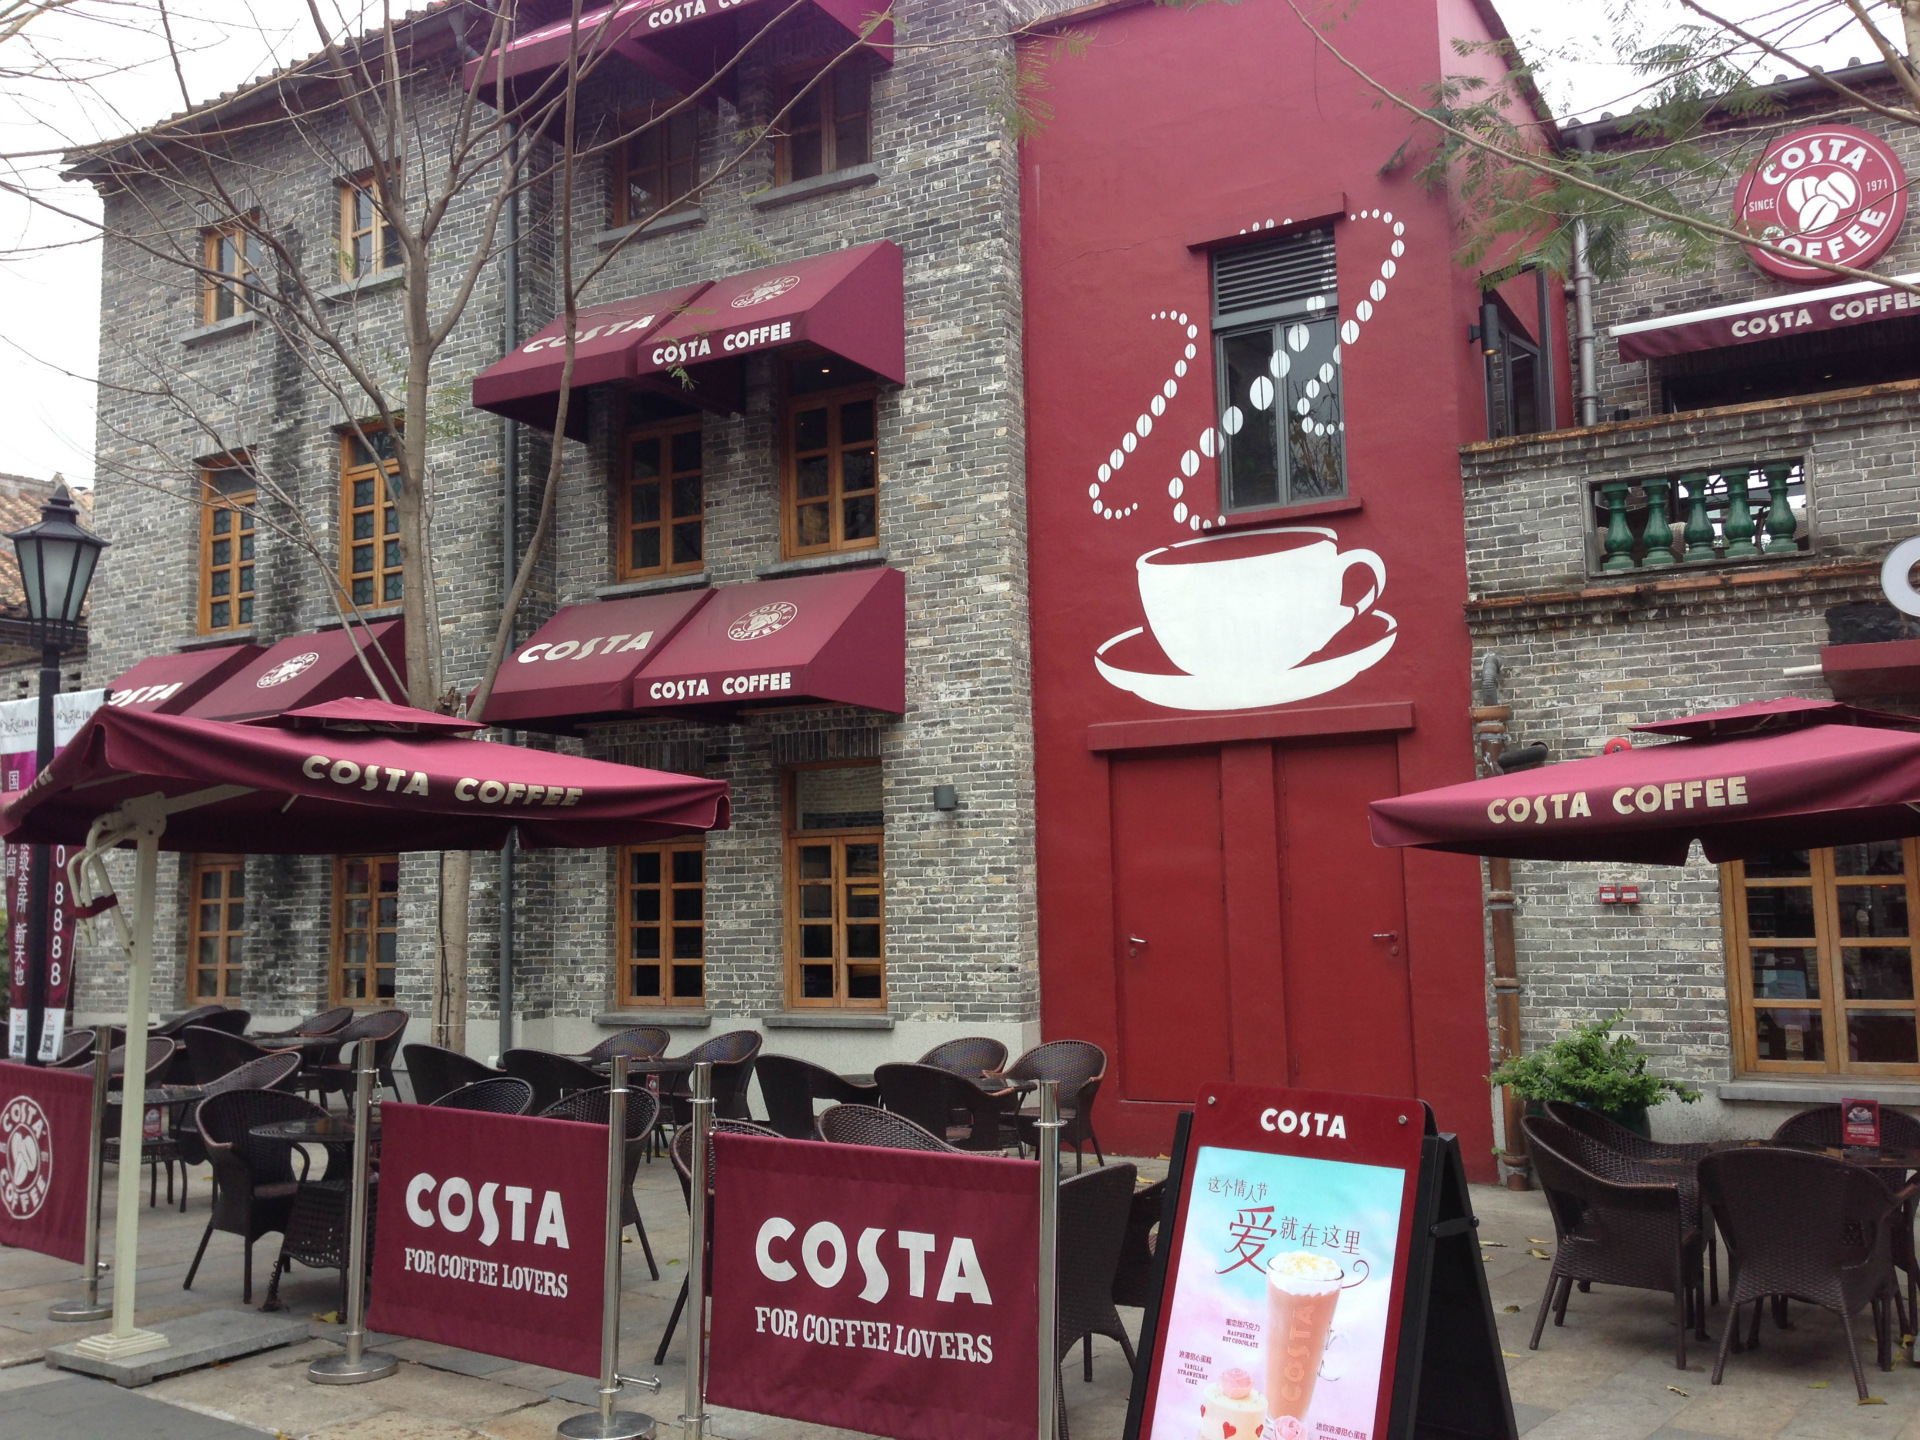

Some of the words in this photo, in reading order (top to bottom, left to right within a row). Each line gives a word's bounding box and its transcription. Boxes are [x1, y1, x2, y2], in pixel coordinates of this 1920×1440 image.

[648, 0, 707, 29] COSTA
[1762, 139, 1867, 185] COSTA
[1866, 179, 1889, 192] 1971
[1749, 198, 1775, 213] SINCE
[522, 314, 656, 354] COSTA
[1731, 309, 1813, 338] COSTA
[652, 338, 712, 366] COSTA
[723, 321, 791, 352] COFFEE
[517, 630, 655, 664] COSTA
[107, 681, 184, 707] OSTA
[650, 679, 709, 700] COSTA
[722, 672, 791, 695] COFFEE
[302, 754, 429, 797] COSTA
[454, 777, 584, 807] COFFEE
[1487, 791, 1592, 825] COSTA
[1612, 776, 1749, 815] COFFEE
[3, 1102, 43, 1140] COSTA
[1260, 1107, 1347, 1140] COSTA
[0, 1168, 47, 1214] COFFEE
[1207, 1176, 1269, 1203] 这个情人节
[405, 1172, 570, 1250] COSTA
[404, 1247, 437, 1276] FOR
[438, 1253, 498, 1288] COFFEE
[501, 1263, 568, 1299] LOVERS
[755, 1216, 993, 1306] COSTA
[755, 1306, 799, 1340] FOR
[802, 1313, 891, 1352] COFFEE
[893, 1324, 994, 1364] LOVERS
[1231, 1338, 1260, 1349] CHOCOLATE
[1184, 1362, 1204, 1372] VANILLA
[1281, 1304, 1317, 1402] COSTA
[1177, 1368, 1209, 1381] STRAWBERRY
[1185, 1377, 1198, 1386] CAKE
